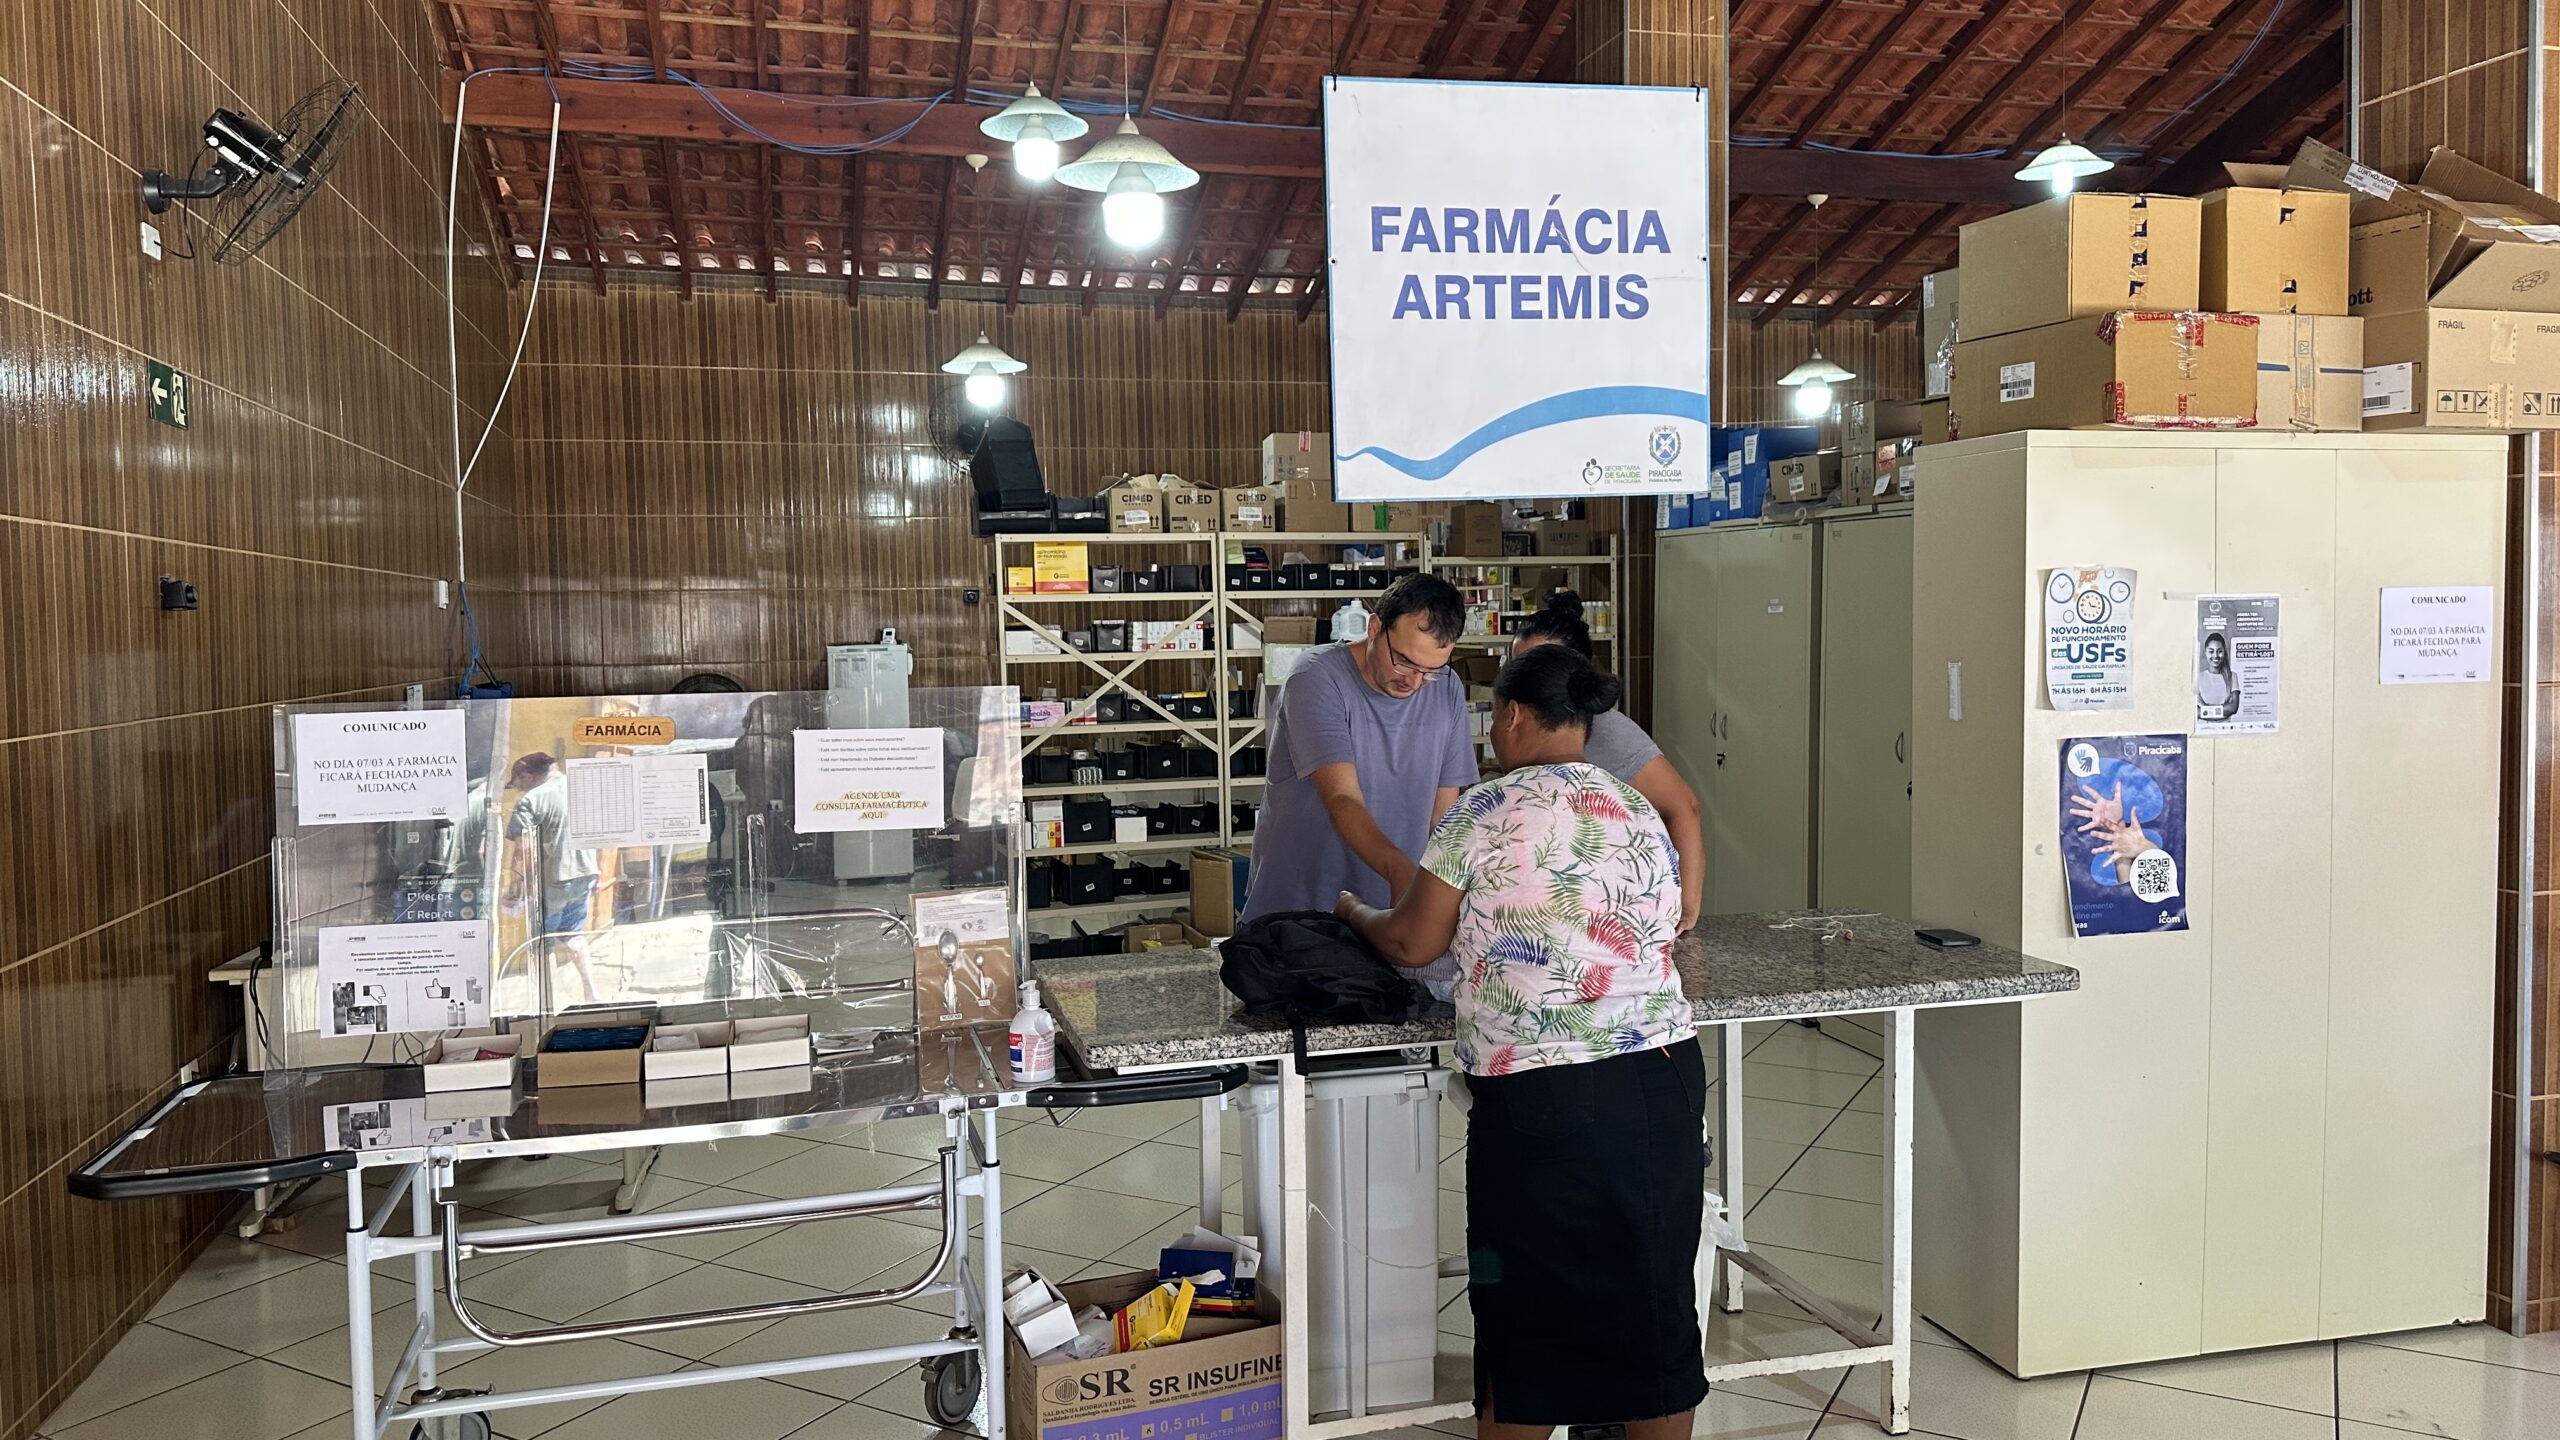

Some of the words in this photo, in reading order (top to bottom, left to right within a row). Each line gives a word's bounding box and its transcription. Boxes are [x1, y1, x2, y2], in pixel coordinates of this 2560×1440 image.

[1370, 194, 1672, 254] FARMÁCIA
[1392, 274, 1650, 320] ARTEMIS
[1176, 495, 1212, 504] CIMED
[2412, 596, 2466, 604] COMUNICADO
[2082, 625, 2126, 634] HORÁRIO
[2390, 627, 2402, 636] NO
[2404, 627, 2417, 635] DIA
[2445, 624, 2485, 634] FARMÁCIA
[2393, 636, 2422, 646] FICARÁ
[2424, 638, 2459, 646] FECHADA
[2461, 636, 2481, 644] PARA
[2067, 643, 2126, 663] USFs
[2418, 648, 2457, 657] MUDANÇA
[343, 722, 426, 733] COMUNICADO
[585, 722, 661, 736] FARMÁCIA
[2139, 746, 2181, 755] Piracicaba
[314, 760, 330, 769] NO
[334, 759, 354, 768] DIA
[357, 758, 383, 767] 07/03
[386, 758, 394, 766] A
[397, 755, 457, 766] FARMÁCIA
[320, 769, 362, 782] FICARÁ
[365, 770, 419, 780] FECHADA
[422, 769, 452, 777] PARA
[357, 782, 416, 793] MUDANÇA
[816, 802, 860, 810] CONSULTA
[862, 800, 927, 809] FARMACÊUTICA
[2158, 916, 2180, 924] icom
[1149, 1376, 1180, 1397] SR
[1188, 1354, 1282, 1390] INSUFINE
[1080, 1368, 1134, 1401] SR
[1043, 1408, 1078, 1417] SALDANHA
[1080, 1401, 1117, 1411] RODRIGUES
[1075, 1410, 1100, 1418] tecnologia
[1240, 1401, 1259, 1416] 1,0
[1160, 1417, 1182, 1433] 0,5
[1186, 1414, 1209, 1428] mL
[1200, 1427, 1233, 1440] BLISTER
[1236, 1418, 1279, 1432] INDIVIDUAL
